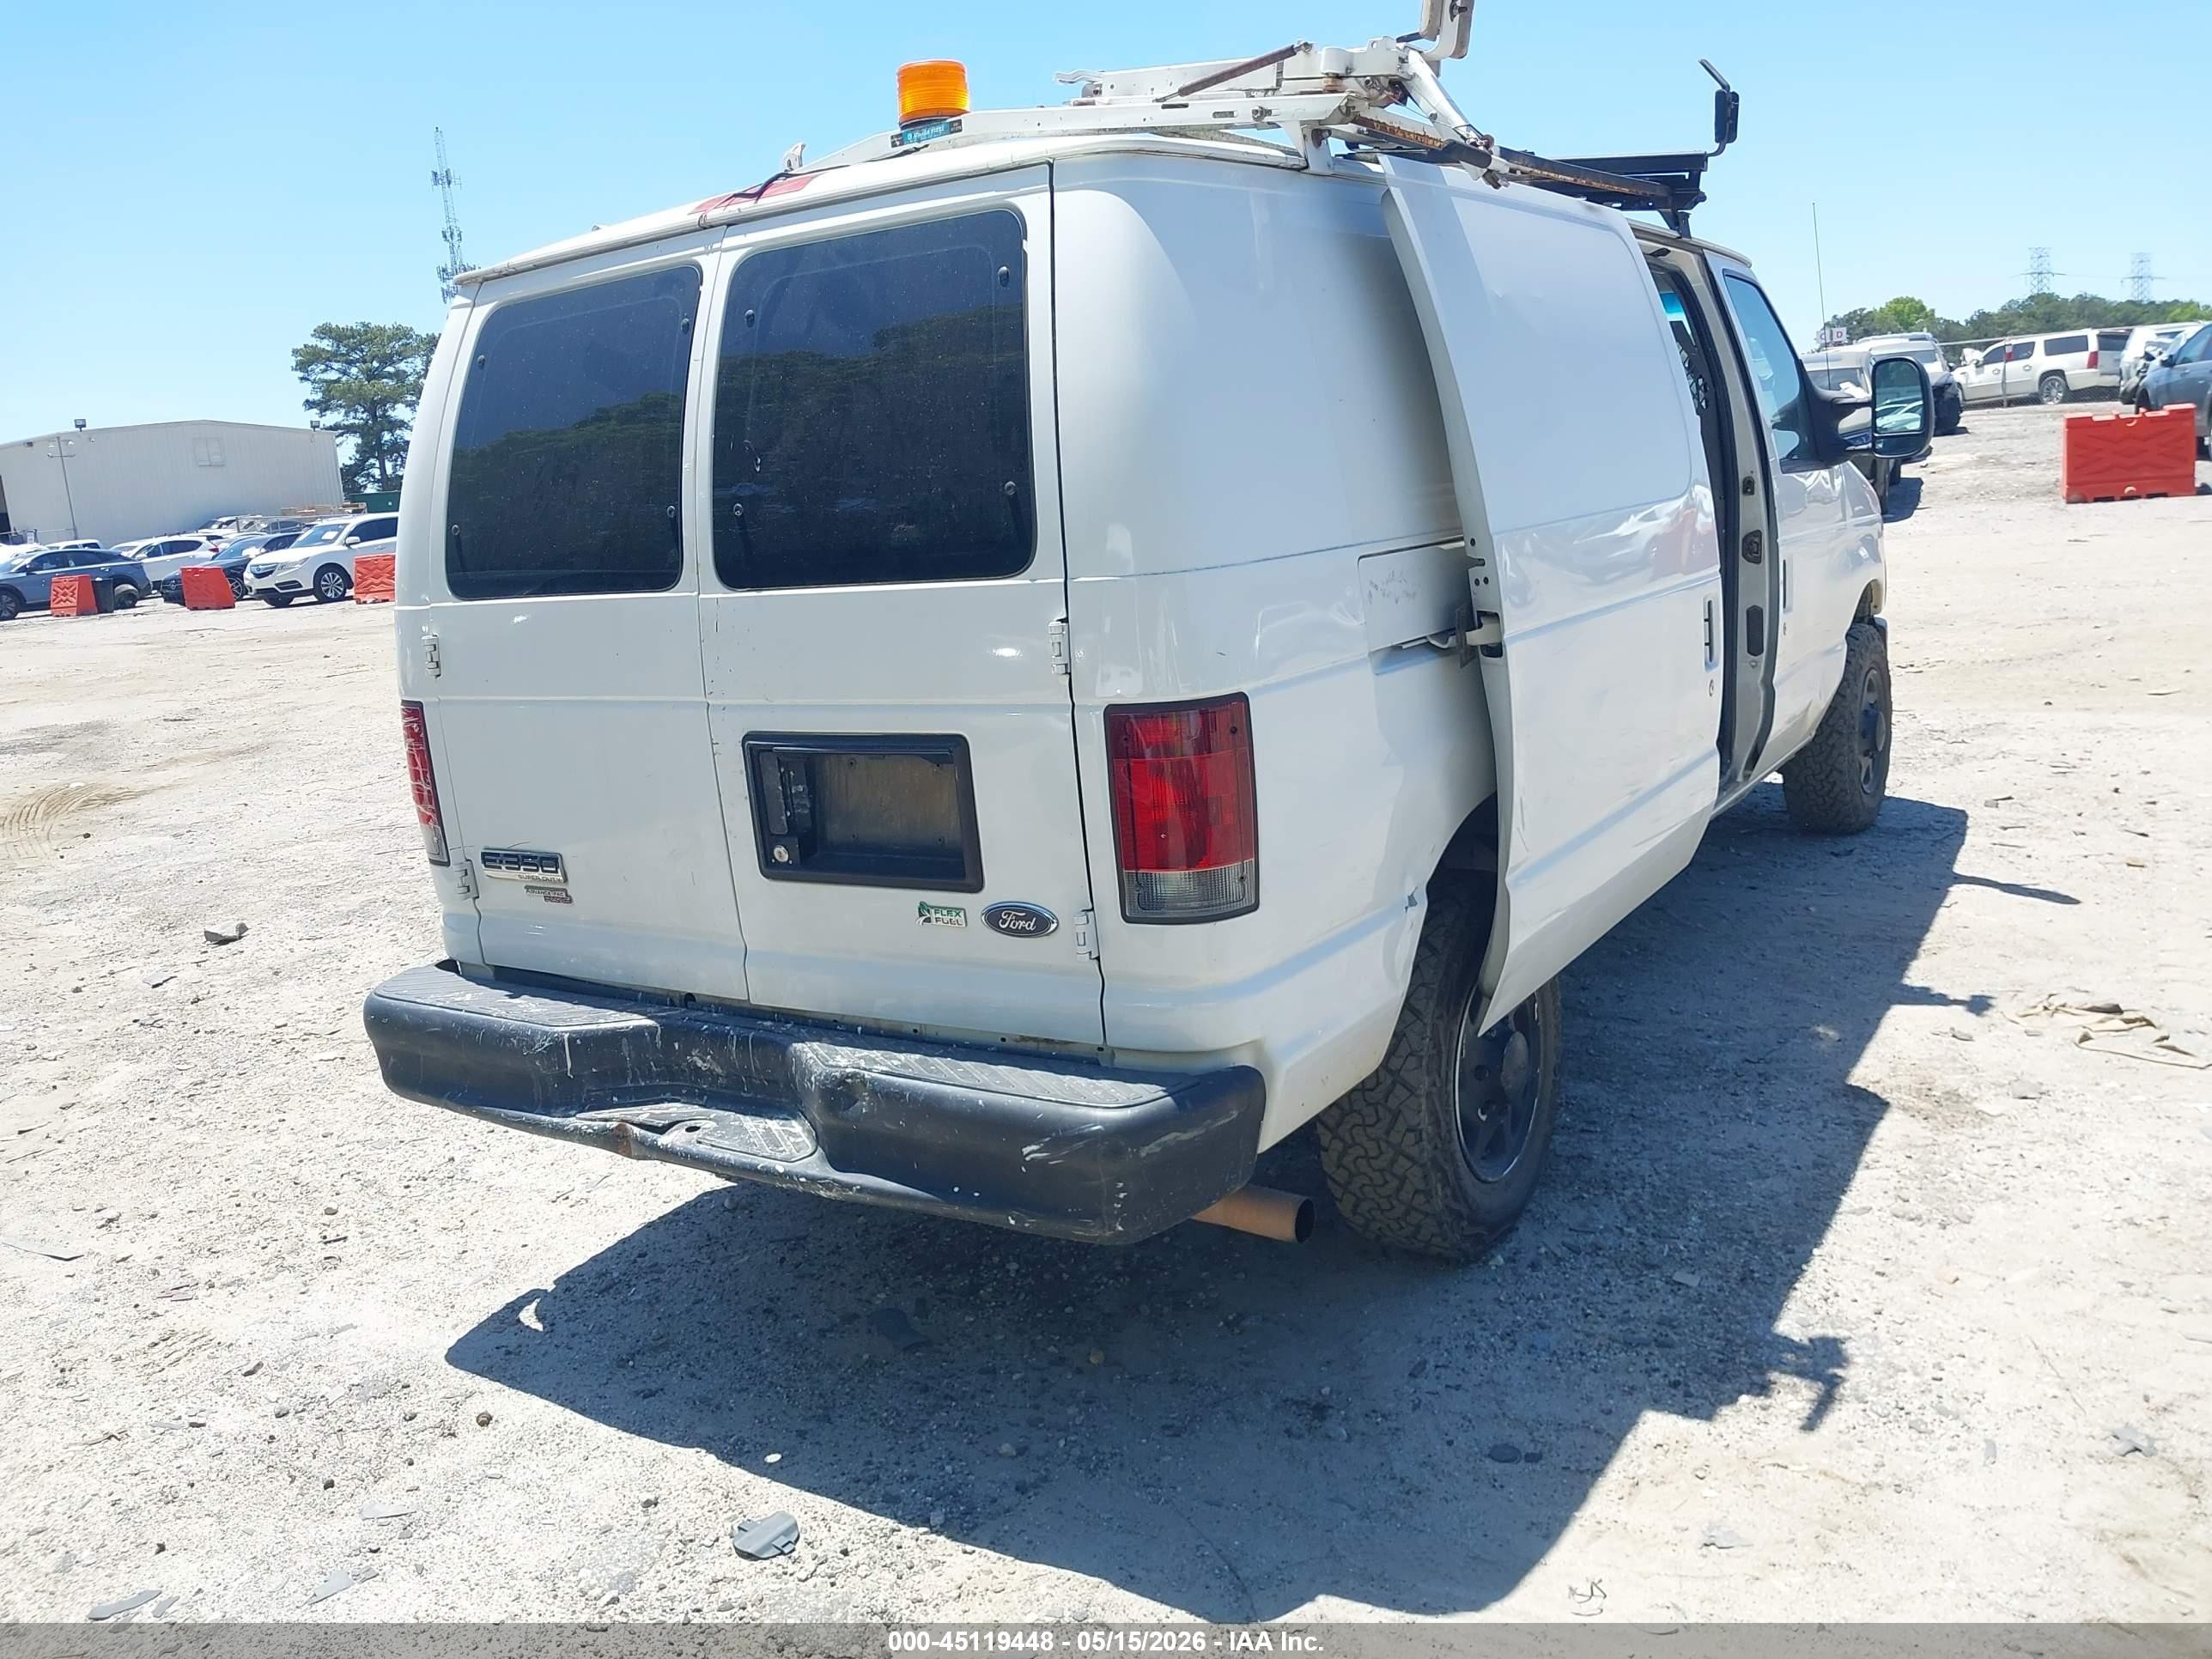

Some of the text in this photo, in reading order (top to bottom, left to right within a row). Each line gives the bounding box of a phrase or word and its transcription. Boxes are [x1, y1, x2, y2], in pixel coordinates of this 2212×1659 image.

[933, 908, 963, 918] FLEX
[934, 917, 963, 927] FUEL
[999, 909, 1036, 931] Ford
